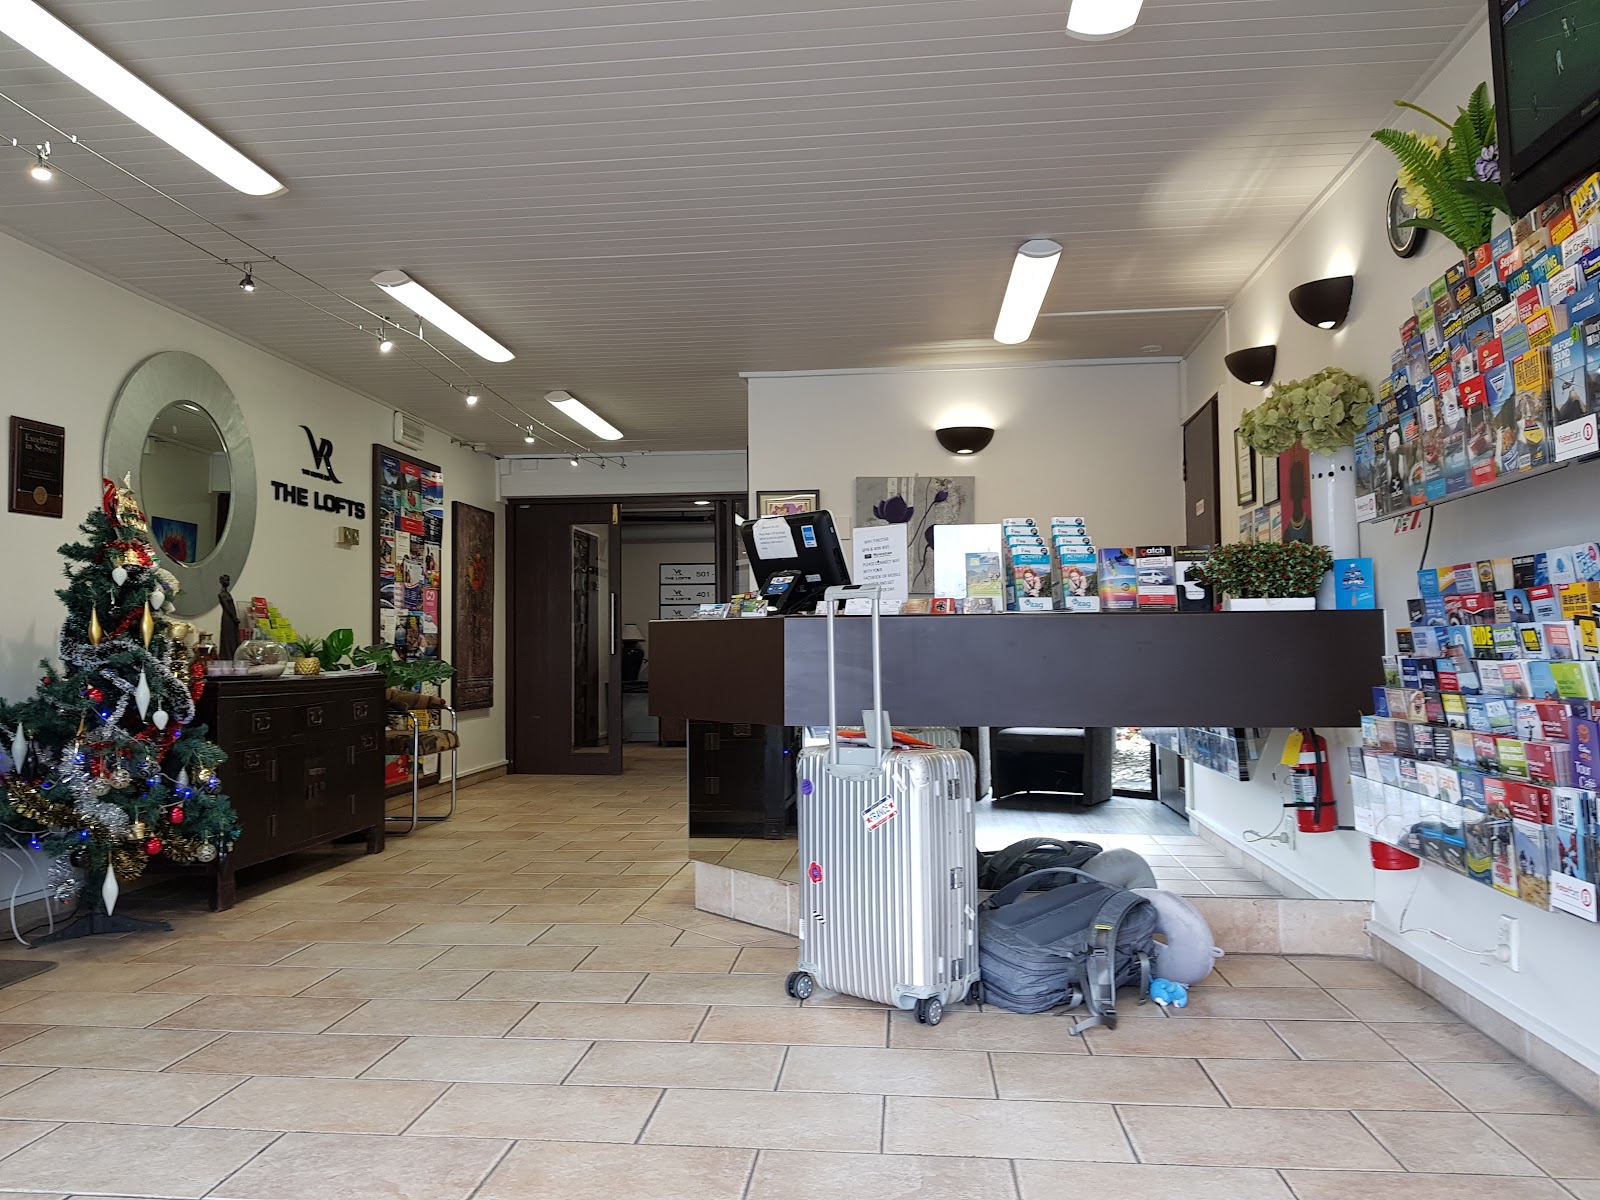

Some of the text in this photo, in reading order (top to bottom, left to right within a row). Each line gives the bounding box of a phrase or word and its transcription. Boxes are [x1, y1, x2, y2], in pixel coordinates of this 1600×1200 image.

[1443, 317, 1463, 337] SWING
[1429, 350, 1450, 369] SWING
[270, 480, 366, 520] THE LOFTS
[1471, 625, 1494, 646] RIDE
[1574, 760, 1592, 776] Tour
